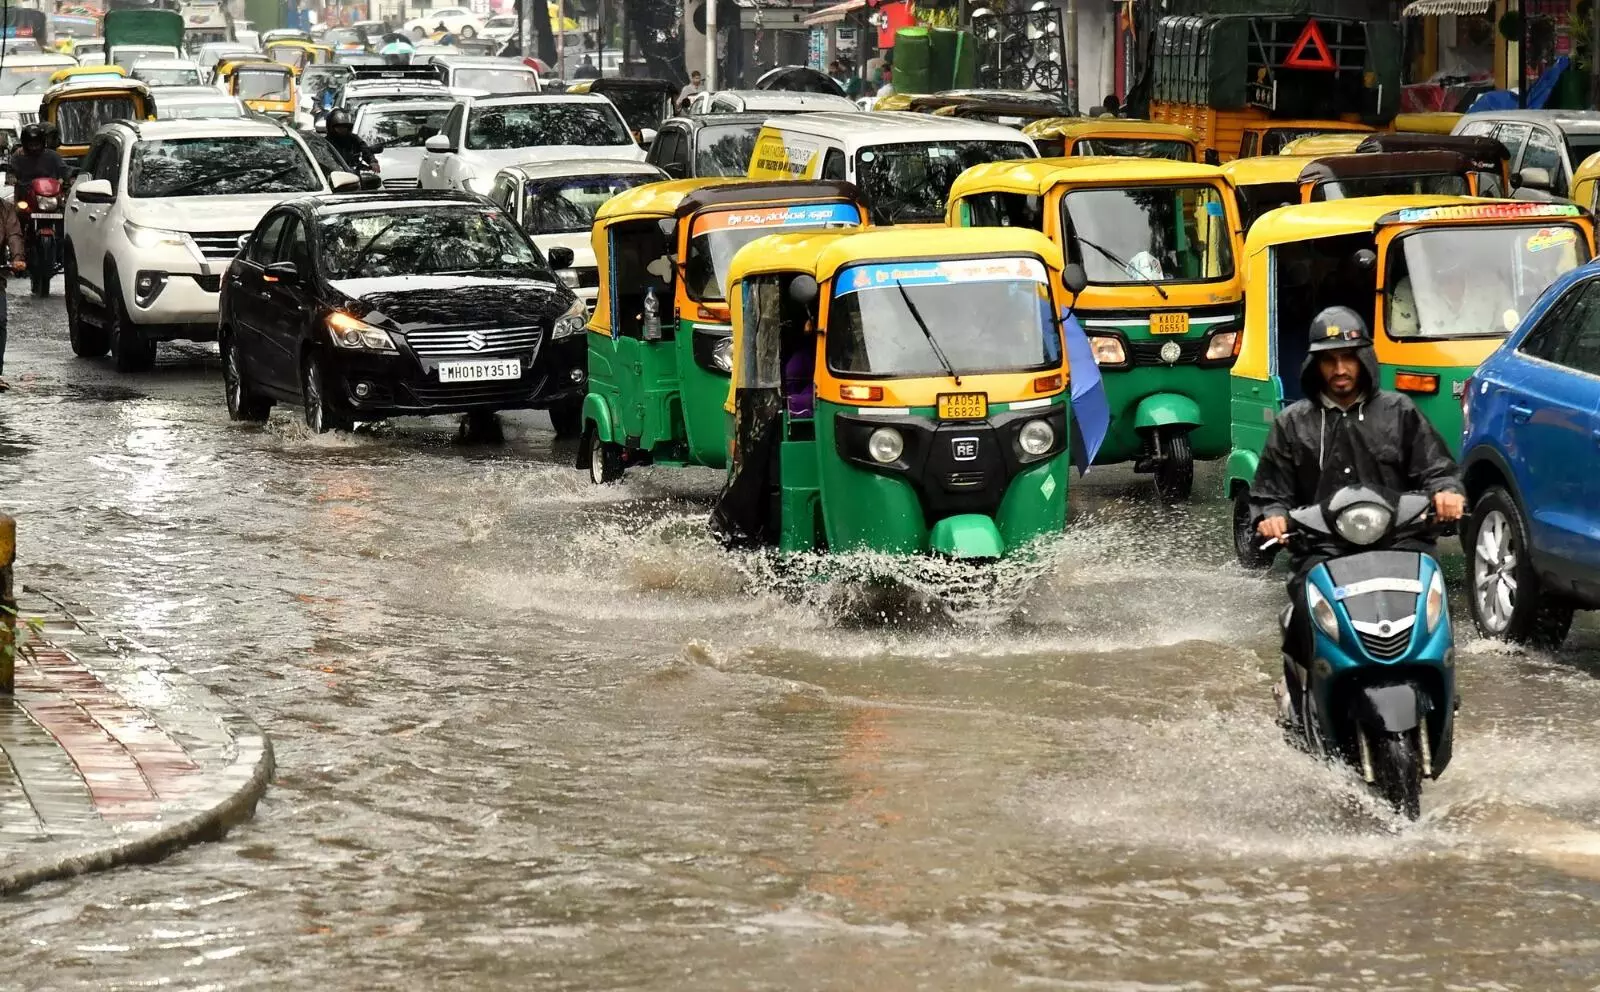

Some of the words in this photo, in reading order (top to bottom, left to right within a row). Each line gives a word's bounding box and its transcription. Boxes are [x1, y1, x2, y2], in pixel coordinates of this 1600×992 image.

[448, 364, 519, 379] MH01BY3513
[947, 394, 980, 406] KA05A
[947, 406, 981, 417] E6825
[956, 445, 975, 456] RE
